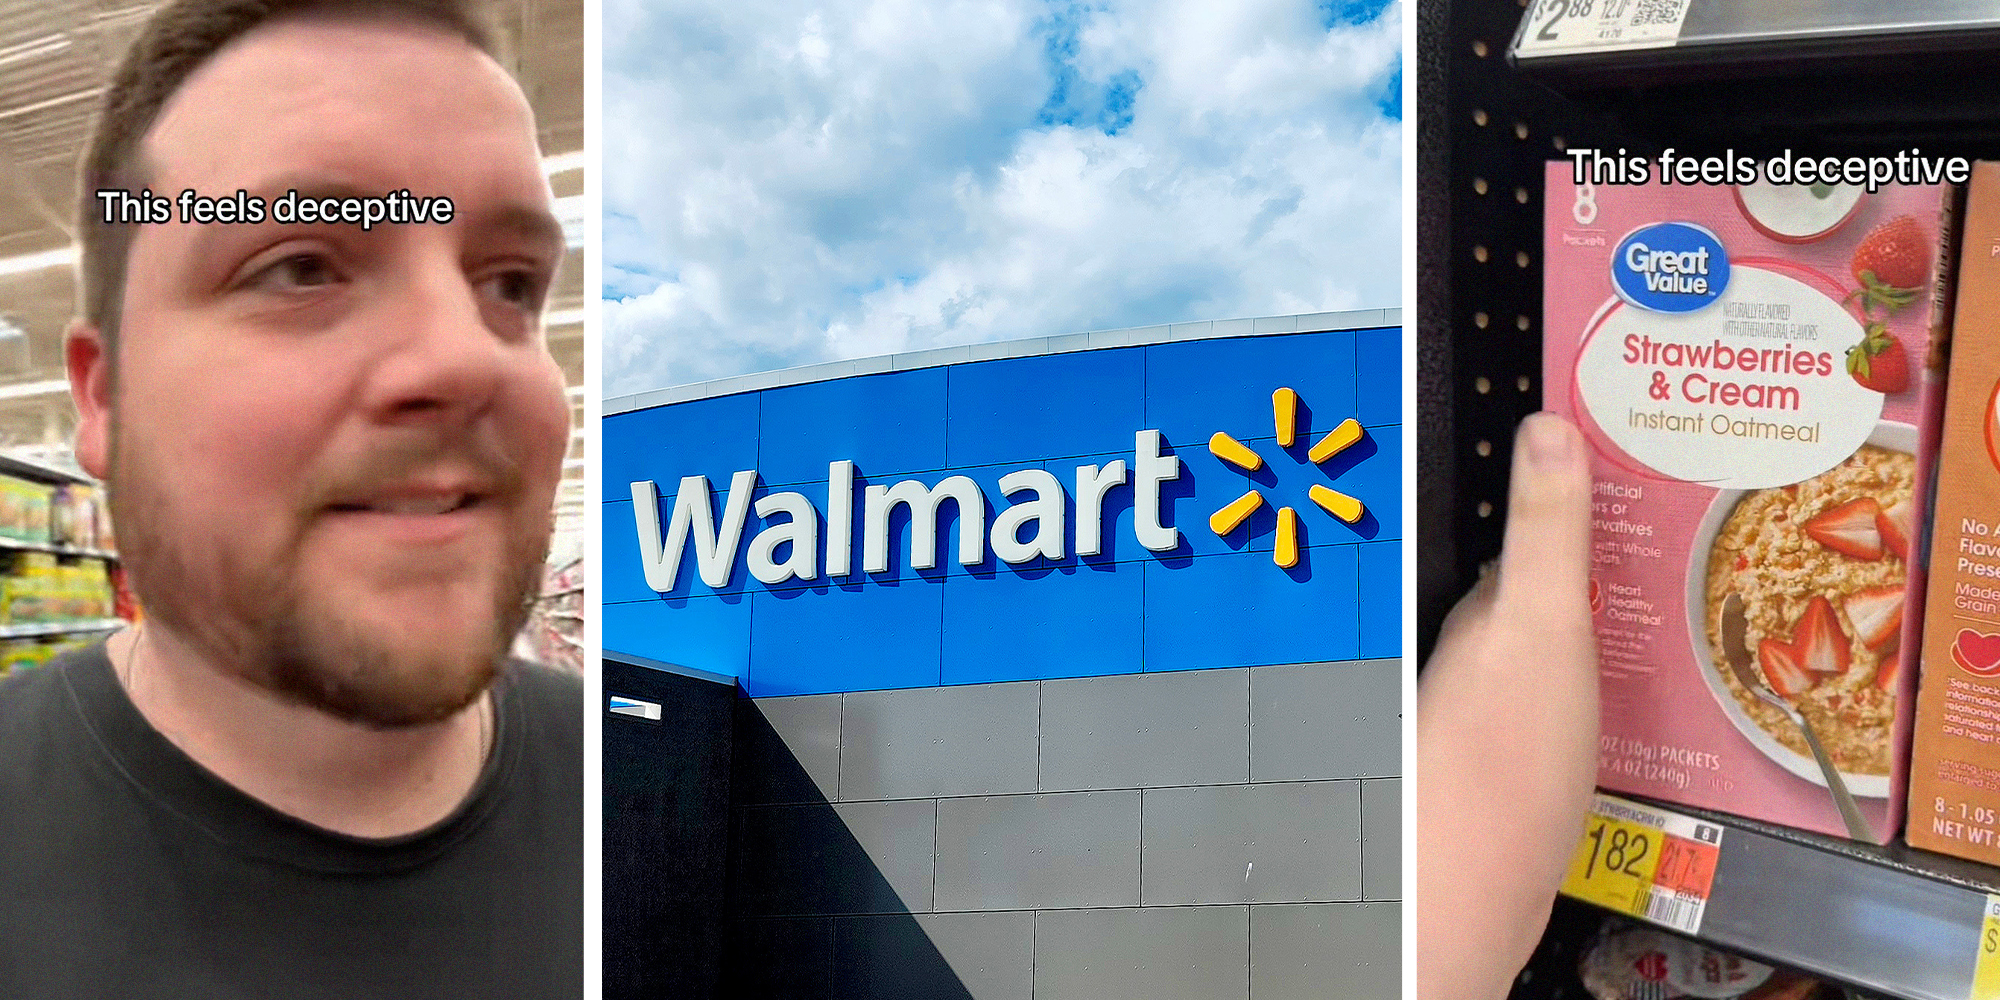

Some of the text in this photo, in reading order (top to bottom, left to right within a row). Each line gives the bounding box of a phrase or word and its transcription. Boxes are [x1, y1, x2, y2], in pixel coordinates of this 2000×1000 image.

[1572, 182, 1598, 225] 8
[1625, 242, 1709, 275] Great
[1644, 272, 1708, 294] Value
[1622, 332, 1833, 377] Strawberries
[1648, 370, 1800, 411] & Cream
[1628, 407, 1821, 444] Instant Oatmeal
[630, 428, 1180, 593] Walmart
[1611, 503, 1628, 515] or
[1961, 517, 1989, 536] No
[1622, 542, 1663, 558] Whole
[1608, 583, 1642, 597] Heart
[1955, 582, 2000, 601] Made
[1608, 595, 1654, 613] Healthy
[1954, 595, 1997, 614] Grain
[1942, 725, 1964, 736] and
[1965, 728, 1994, 742] heart
[1660, 745, 1721, 771] PACKETS
[1645, 763, 1692, 790] (240g)
[1934, 796, 1946, 813] 8
[1959, 803, 1996, 825] 1.05
[1701, 827, 1711, 842] 8
[1932, 814, 1965, 840] NET
[1967, 825, 1995, 847] WT
[1585, 823, 1649, 880] 182
